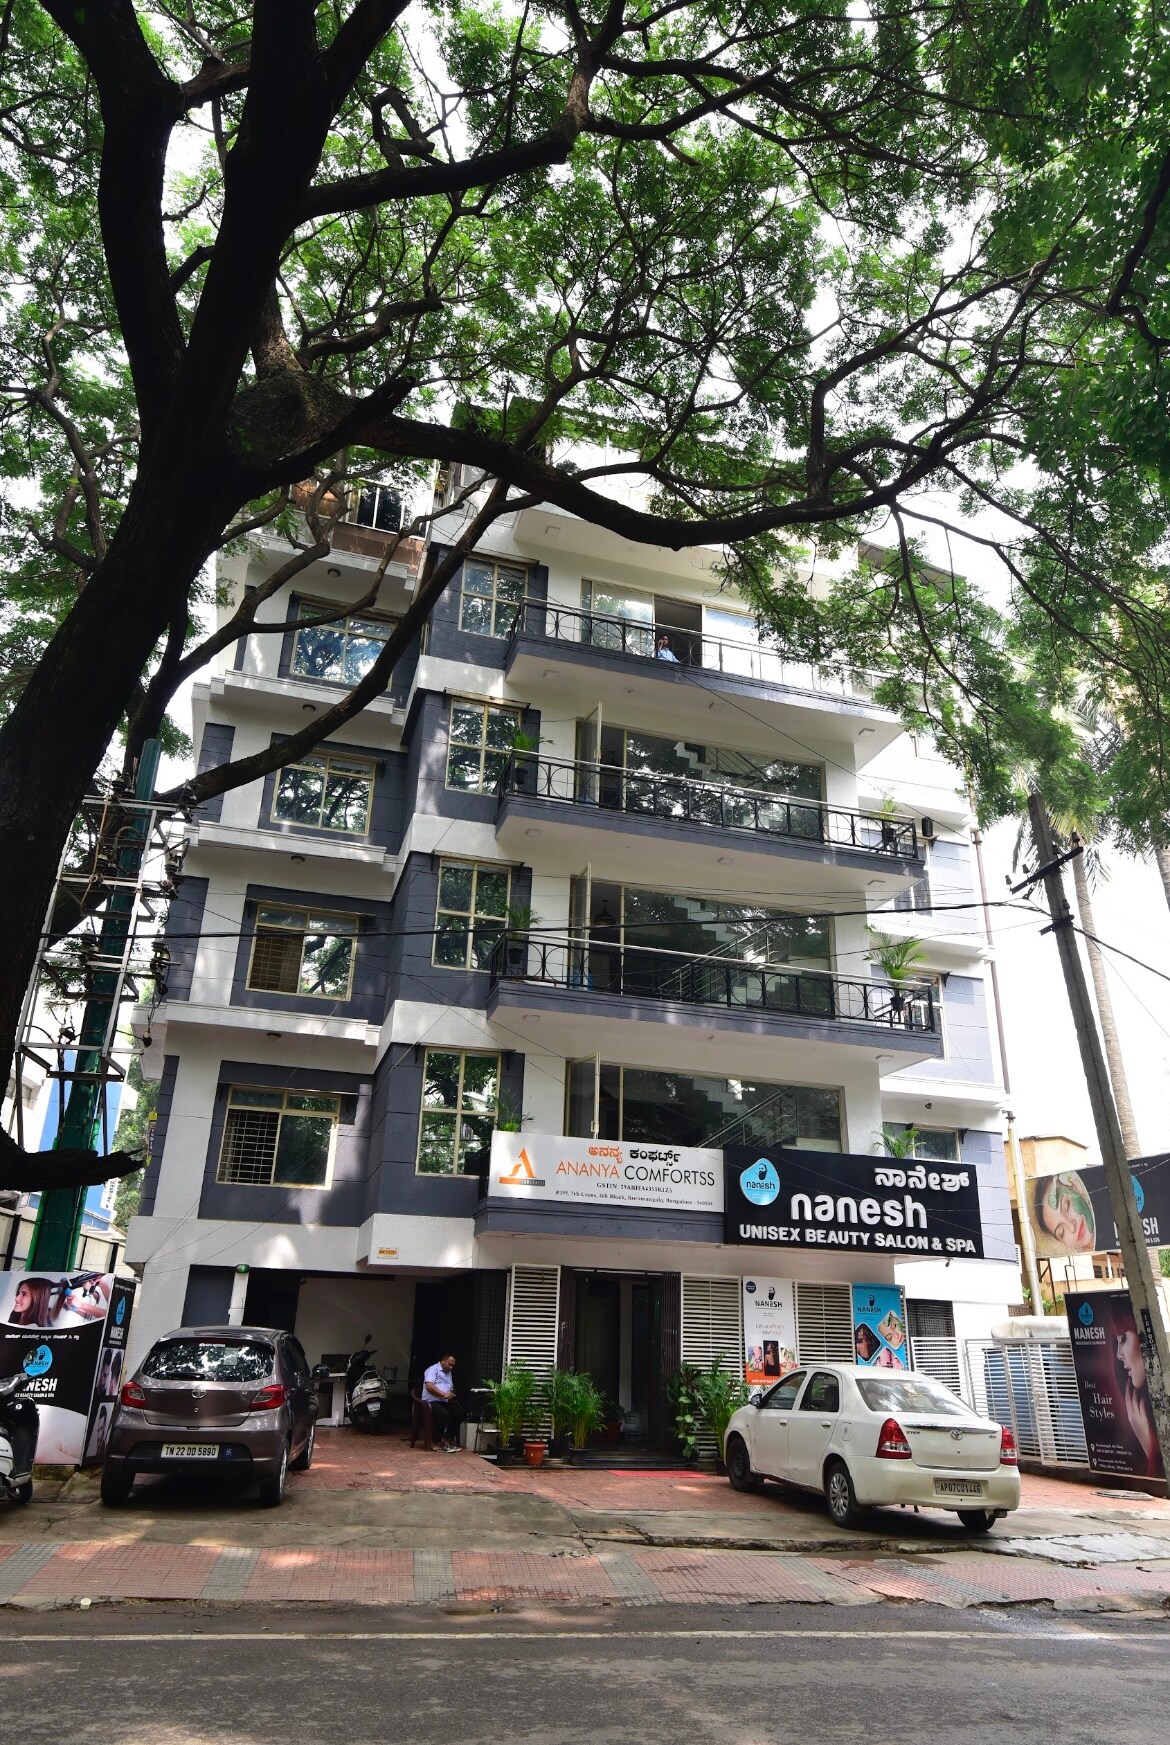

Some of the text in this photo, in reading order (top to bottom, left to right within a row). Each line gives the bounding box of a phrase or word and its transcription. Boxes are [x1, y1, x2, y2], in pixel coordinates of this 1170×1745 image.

[556, 1161, 715, 1186] ANANYA COMFORTSS
[874, 1165, 970, 1192] ನಾನೇಶ್
[790, 1193, 928, 1229] nanesh
[739, 1224, 976, 1253] UNISEX BEAUTY SALON & SPA
[1074, 1327, 1106, 1340] NANESH
[1093, 1393, 1112, 1405] Hair
[1089, 1406, 1115, 1421] Styles
[165, 1446, 175, 1456] TN
[175, 1447, 186, 1456] 22
